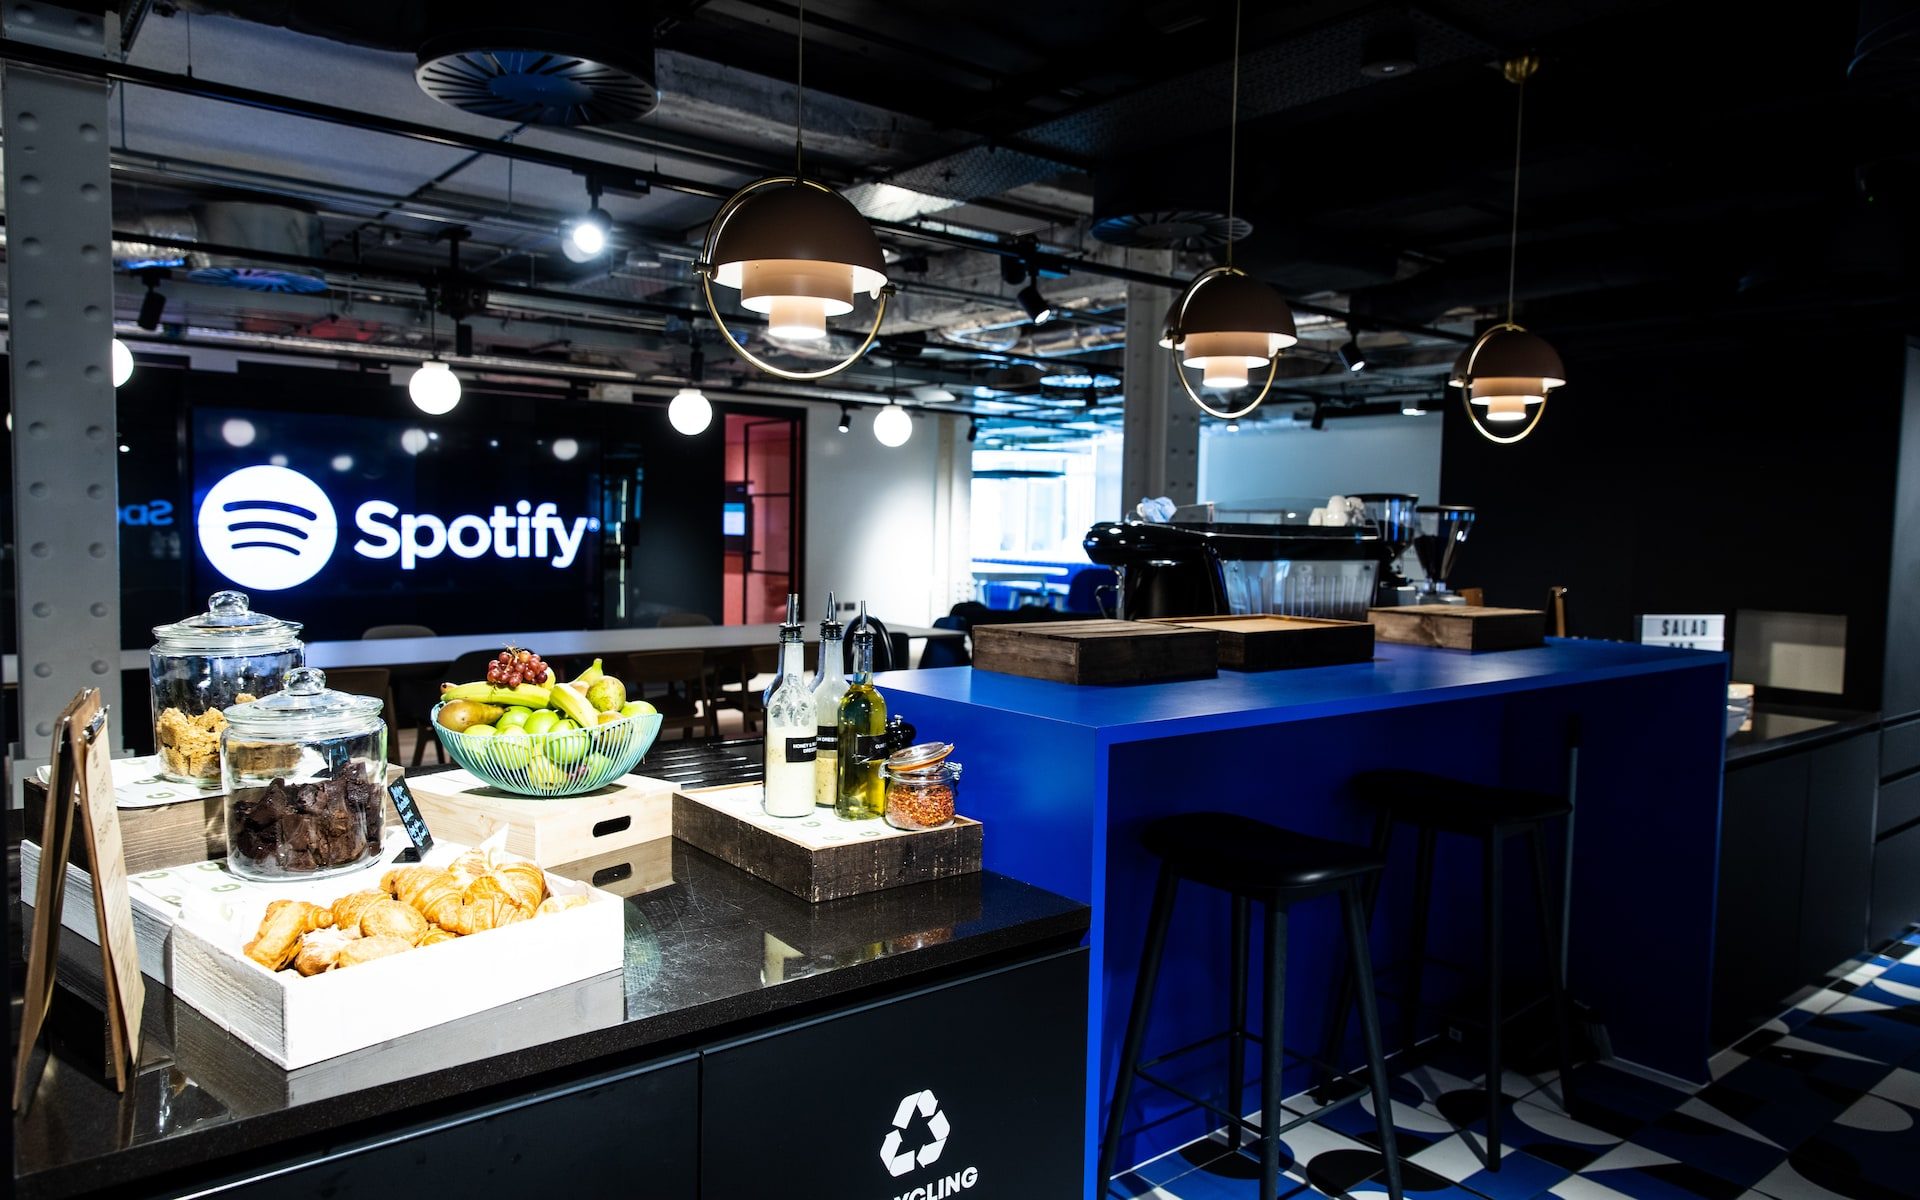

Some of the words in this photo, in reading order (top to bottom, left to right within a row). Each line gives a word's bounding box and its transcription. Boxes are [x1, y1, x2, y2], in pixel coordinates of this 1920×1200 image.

[353, 500, 588, 570] Spotify
[1662, 619, 1707, 636] SALAD
[894, 1166, 978, 1200] CLING
